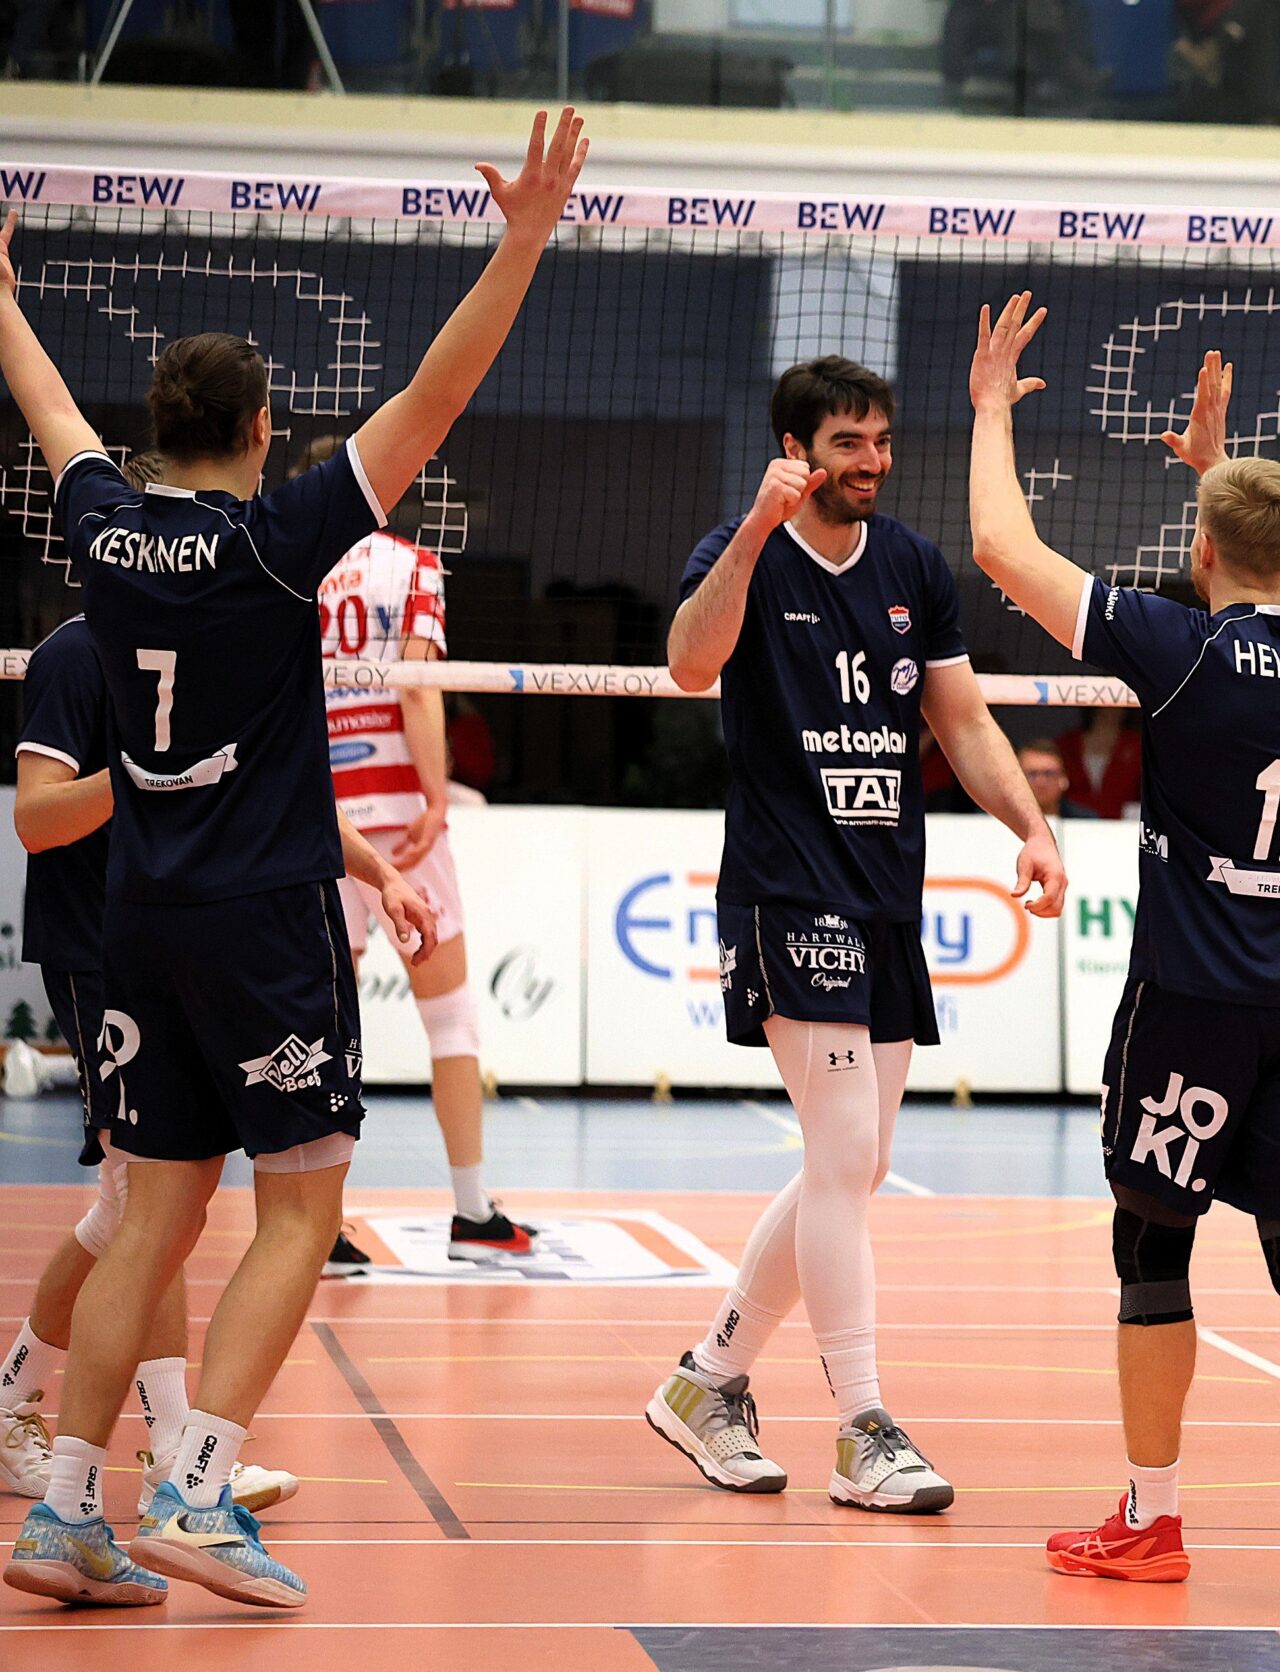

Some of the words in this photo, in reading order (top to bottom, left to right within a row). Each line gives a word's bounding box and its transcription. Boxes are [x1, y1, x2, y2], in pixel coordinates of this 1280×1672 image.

[0, 170, 46, 200] WI
[93, 175, 184, 206] BEWI
[231, 182, 321, 211] BEWI
[402, 188, 491, 217] BEWI
[560, 194, 624, 222] EWI
[668, 198, 755, 226] BEWI
[798, 202, 885, 230] BEWI
[929, 208, 1015, 235] BEWI
[1059, 212, 1144, 239] BEWI
[1188, 216, 1272, 243] BEWI
[89, 527, 218, 573] KESKNEN
[354, 667, 391, 687] OY
[532, 671, 617, 692] VEXVE
[624, 674, 659, 695] OY
[835, 650, 871, 705] 16
[136, 648, 177, 752] 7
[145, 774, 194, 789] TREKOVAN
[827, 776, 898, 810] TAI
[787, 931, 866, 949] HARTWALL
[786, 947, 866, 975] VICHY
[811, 971, 852, 992] Original
[284, 1069, 322, 1093] Beef
[1139, 1071, 1229, 1141] JO
[1129, 1113, 1207, 1193] KI.
[13, 1344, 29, 1376] CRAFT
[135, 1380, 152, 1413] CRAFT
[198, 1434, 218, 1474] CRAFT
[85, 1465, 98, 1500] CRAFT
